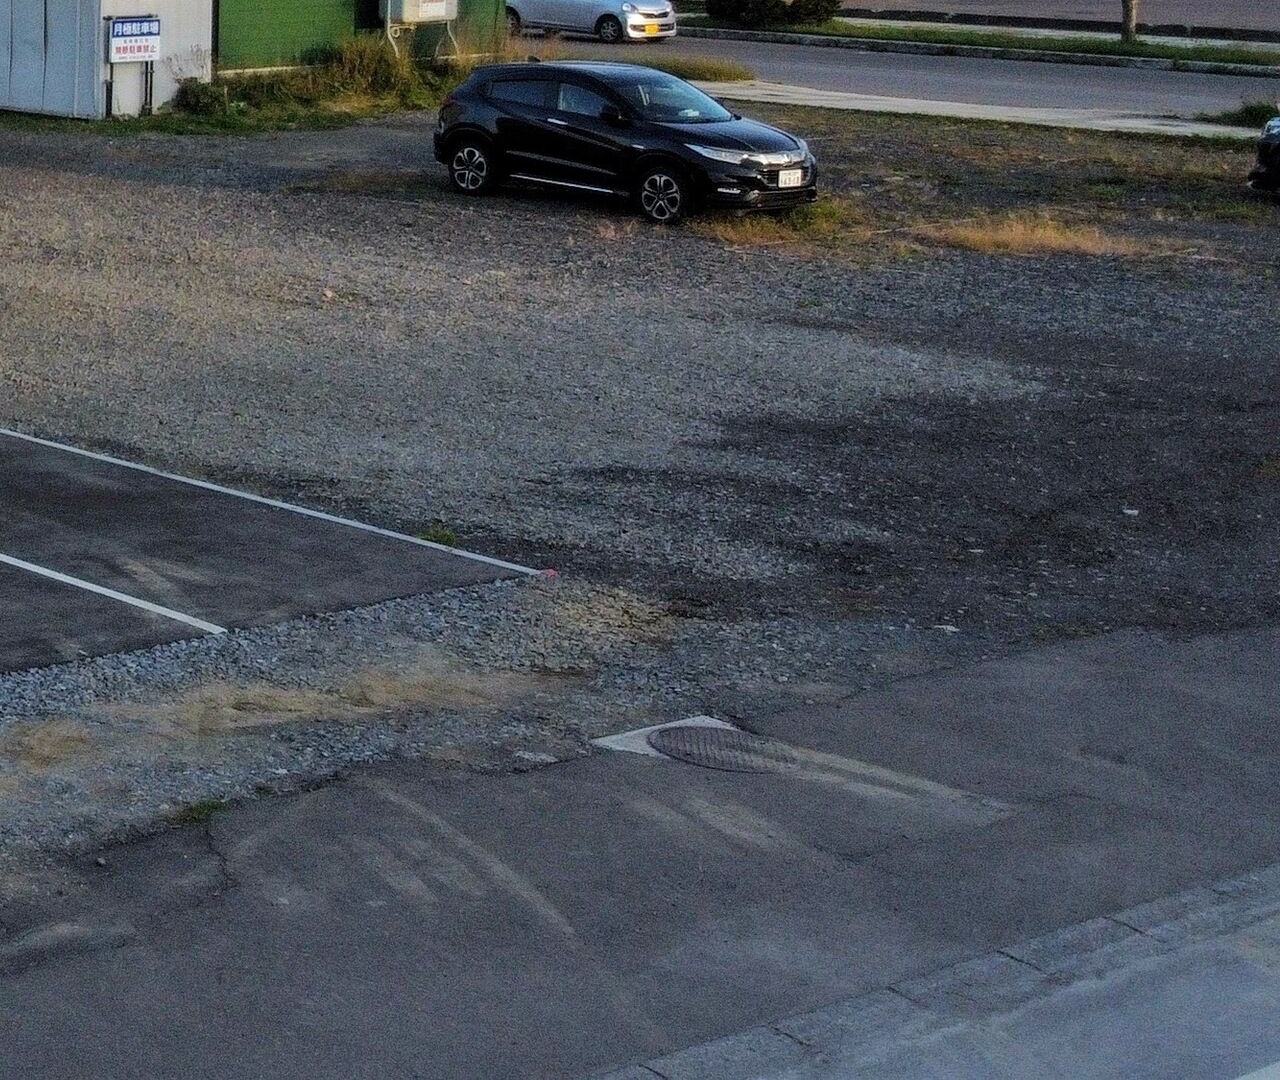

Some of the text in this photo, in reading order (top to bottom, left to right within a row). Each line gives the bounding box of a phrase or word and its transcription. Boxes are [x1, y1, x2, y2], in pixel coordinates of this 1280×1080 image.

[114, 21, 159, 35] 月極駐車場
